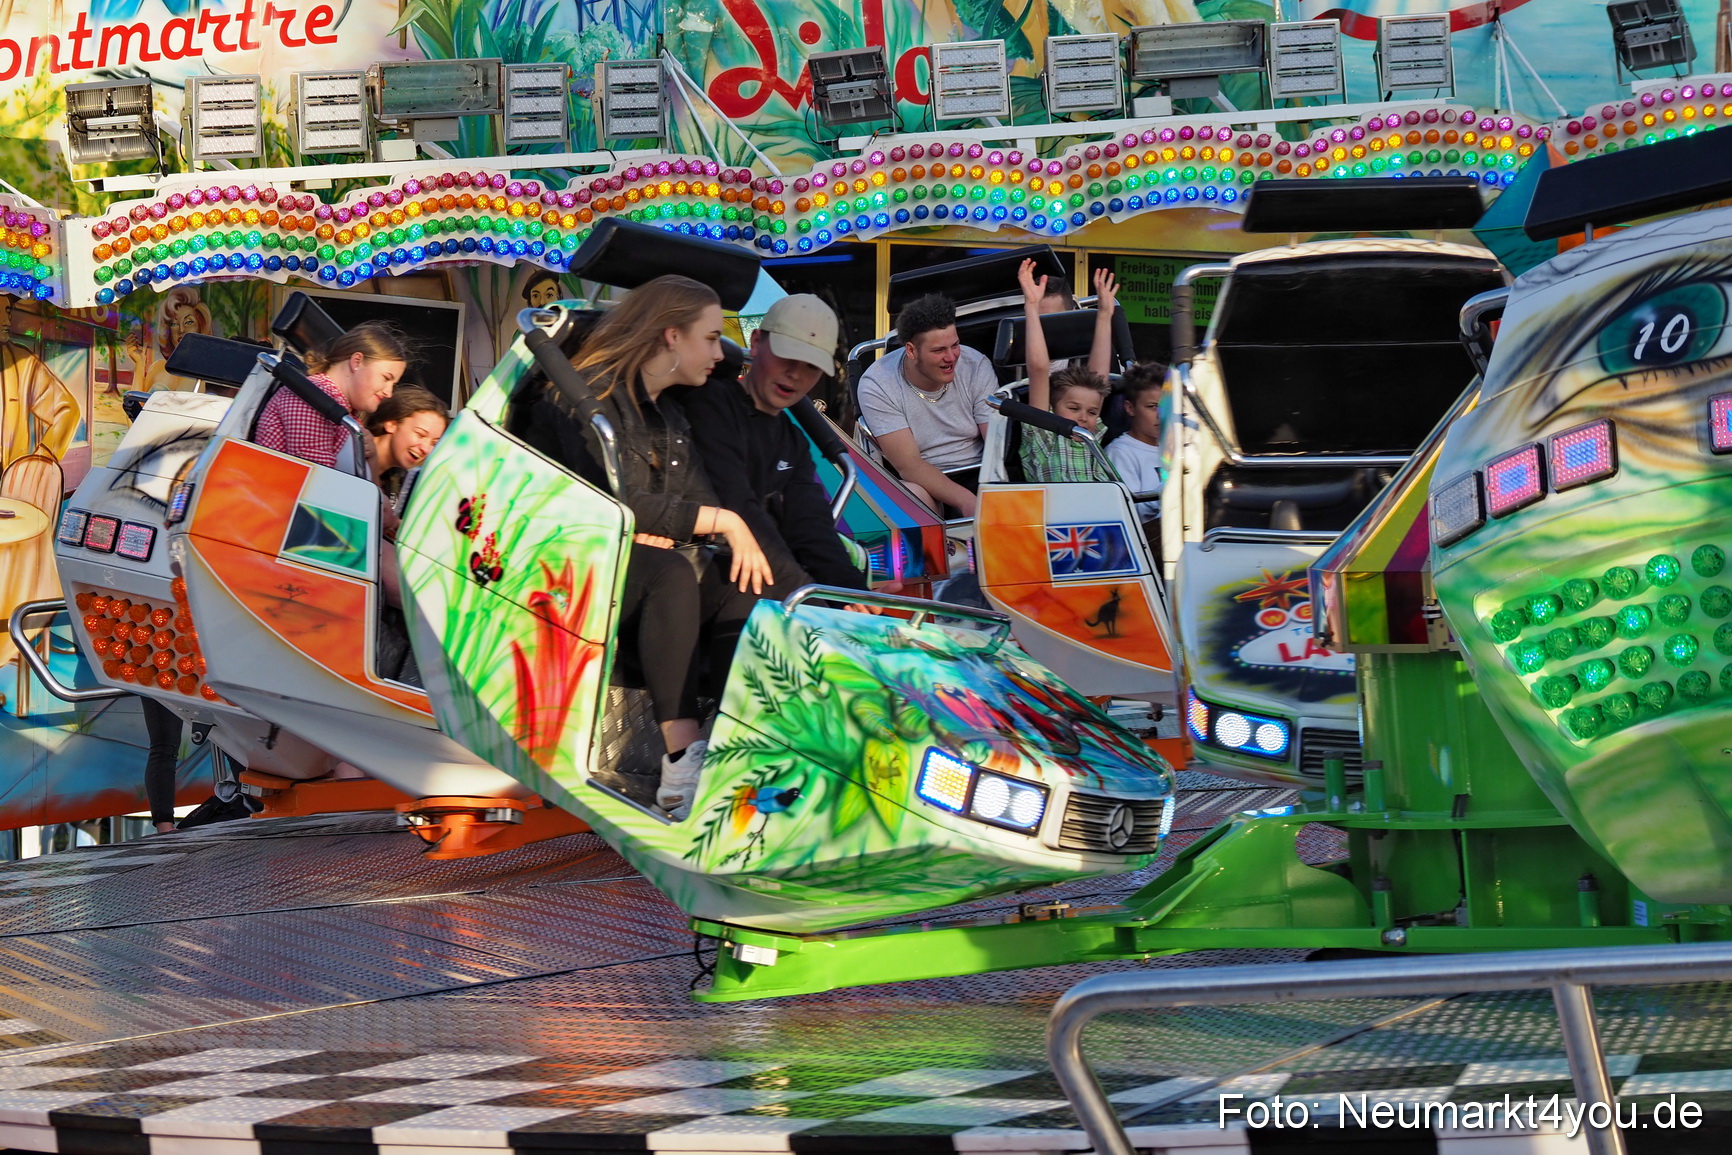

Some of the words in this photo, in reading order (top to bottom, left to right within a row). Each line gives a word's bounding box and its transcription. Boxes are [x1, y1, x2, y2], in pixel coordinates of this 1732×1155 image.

[0, 2, 338, 81] ontmartre
[1121, 261, 1160, 277] Freitag
[1634, 313, 1690, 360] 10
[1277, 637, 1340, 663] LA
